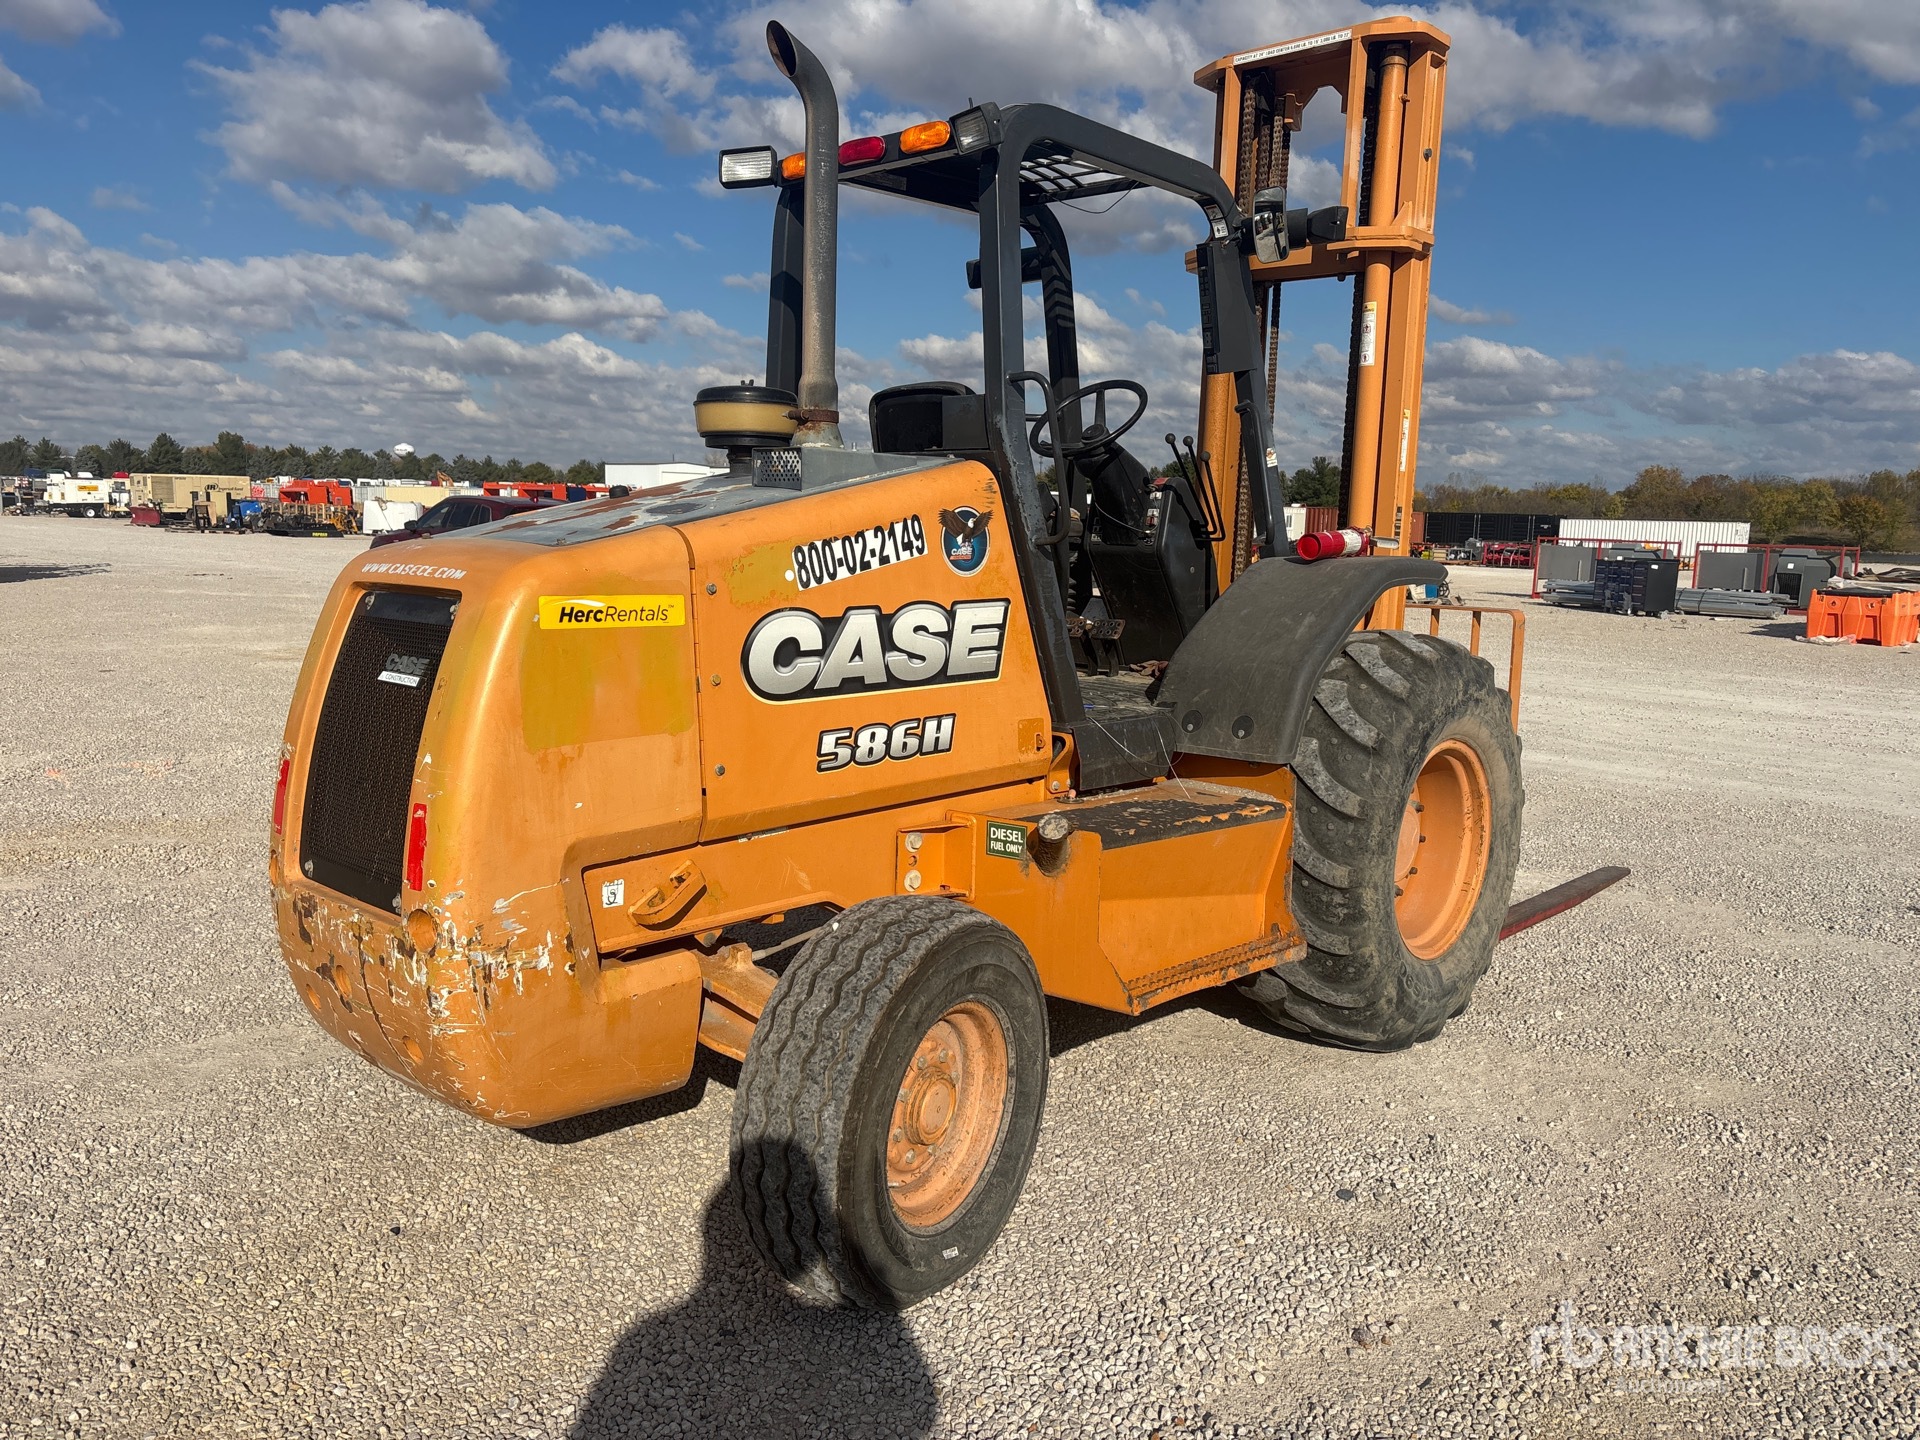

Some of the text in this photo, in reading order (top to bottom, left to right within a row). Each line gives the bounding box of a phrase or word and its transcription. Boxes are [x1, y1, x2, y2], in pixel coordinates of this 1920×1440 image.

[793, 513, 926, 589] 800-02-2149
[951, 547, 972, 556] CASE
[361, 563, 467, 579] WWW.CASECE.COM
[558, 604, 669, 623] HercRentals
[743, 600, 1008, 700] CASE
[385, 653, 430, 675] CASE
[385, 673, 418, 685] CONSTRUCTION
[818, 714, 955, 771] 586H
[990, 827, 1023, 843] DIESEL
[990, 840, 1023, 853] FUEL ONLY
